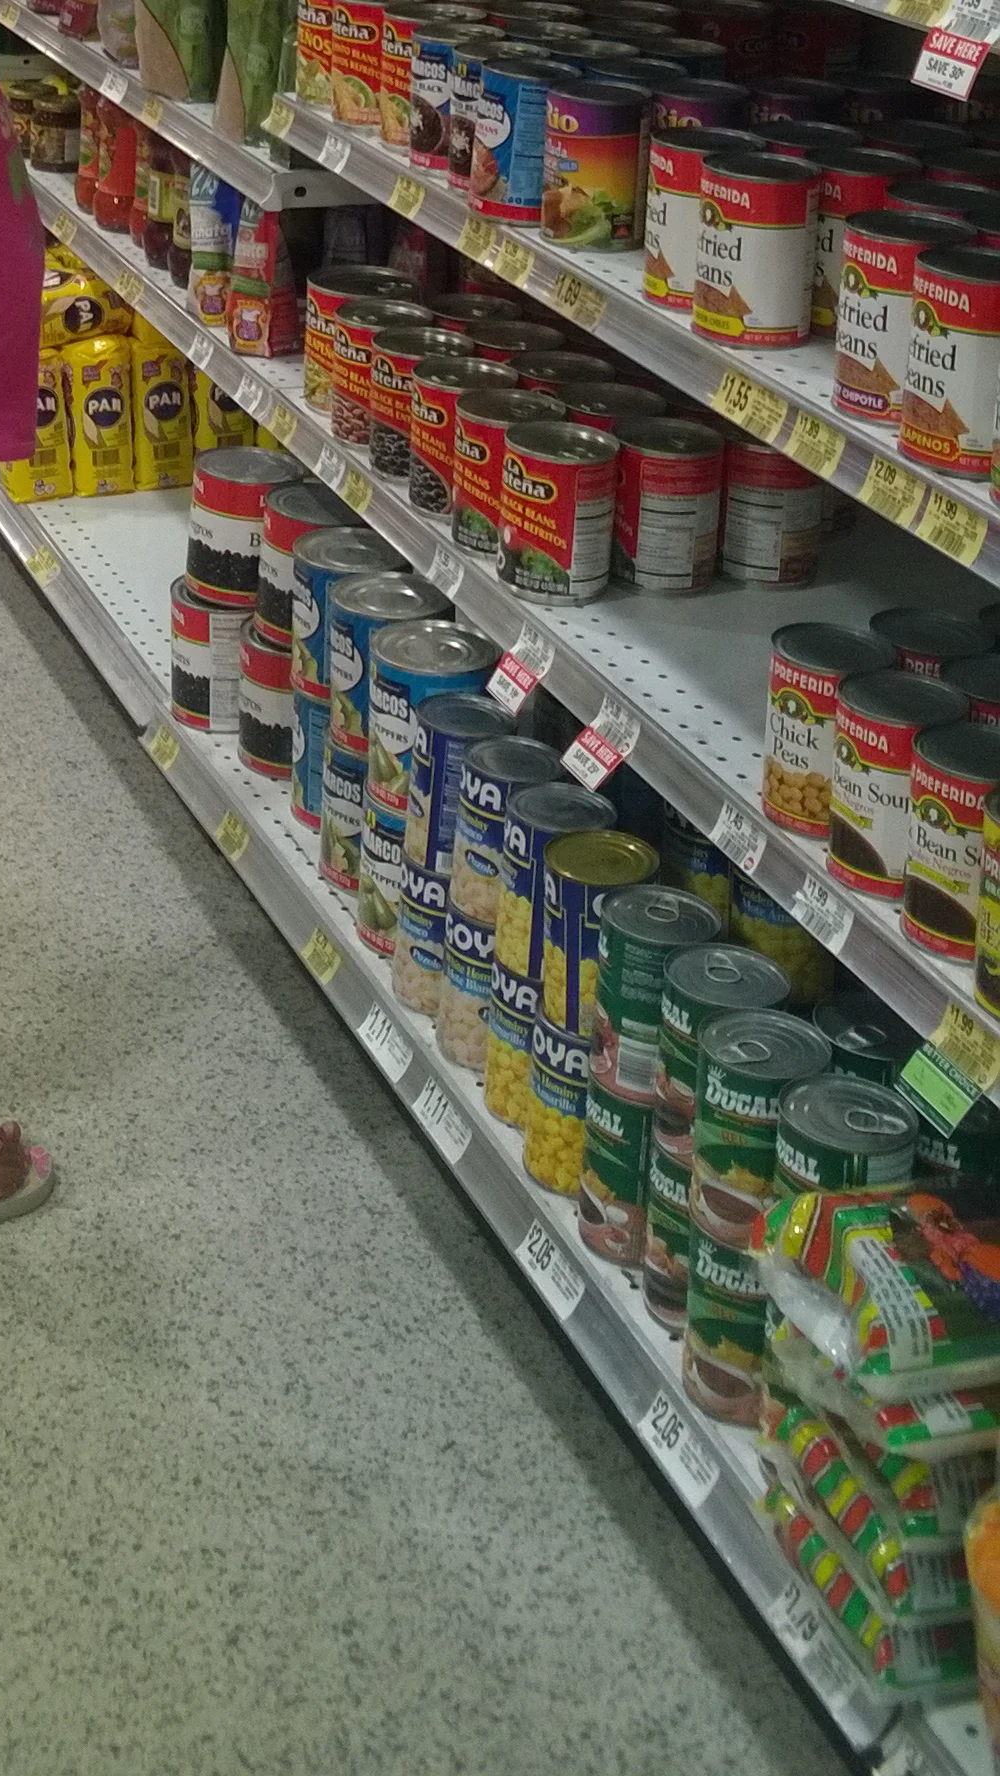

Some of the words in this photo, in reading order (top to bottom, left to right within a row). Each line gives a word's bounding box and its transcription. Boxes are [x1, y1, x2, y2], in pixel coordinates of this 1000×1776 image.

[333, 21, 370, 41] steña
[928, 31, 954, 54] SAVE
[954, 39, 983, 63] HERE
[925, 56, 949, 75] SAVE
[555, 271, 581, 306] $1.69
[698, 263, 733, 287] eans
[837, 294, 888, 332] efried
[722, 374, 749, 413] $1.55
[842, 385, 884, 410] CHIPOTLE
[507, 455, 521, 474] La
[874, 459, 897, 485] $2.09
[504, 473, 548, 499] steña
[525, 505, 556, 531] BEANS
[932, 491, 958, 520] $1.99
[769, 712, 820, 751] Chick
[579, 729, 602, 751] SAVE
[597, 742, 618, 767] HERE
[771, 739, 810, 771] Peas
[916, 827, 960, 865] Bean
[446, 911, 494, 958] GOY
[534, 1023, 589, 1078] OYA
[526, 1225, 552, 1268] $2.05
[655, 1396, 681, 1449] $2.05
